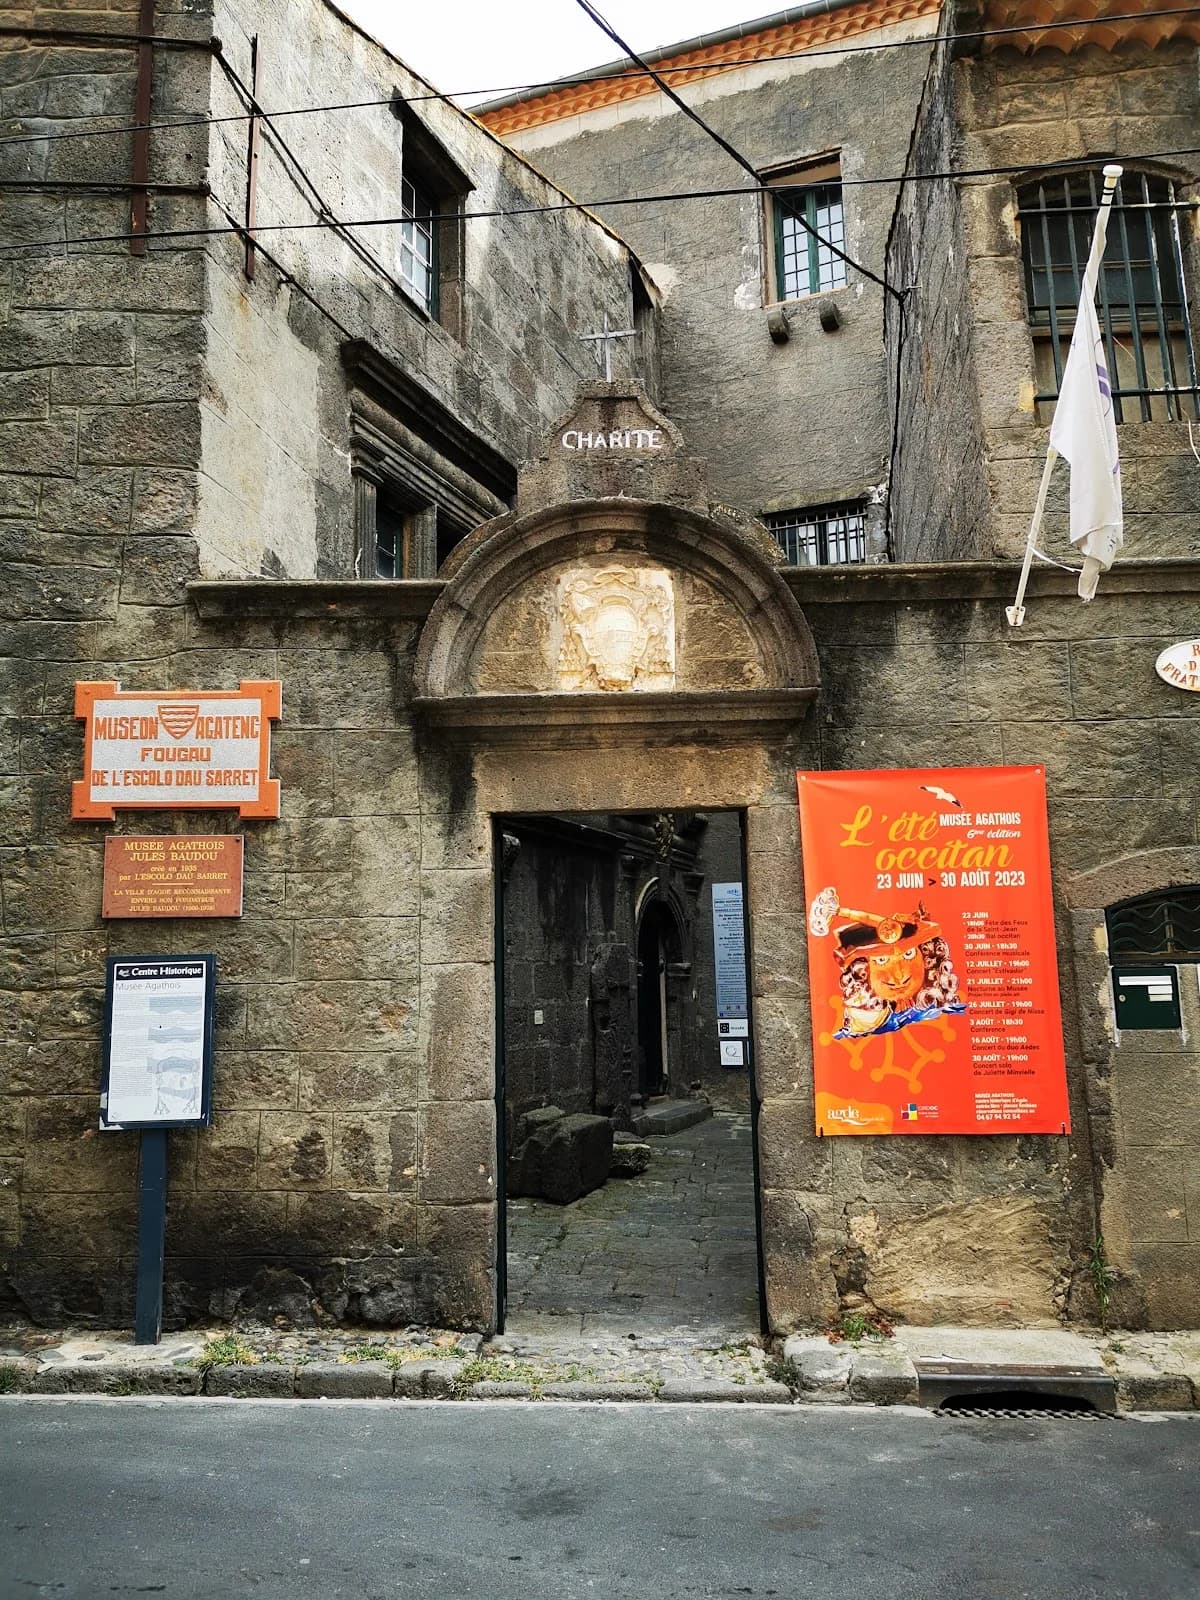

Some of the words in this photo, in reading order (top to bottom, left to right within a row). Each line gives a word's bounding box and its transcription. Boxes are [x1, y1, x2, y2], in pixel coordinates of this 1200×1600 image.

[94, 716, 159, 740] MUSEON
[141, 747, 212, 762] FOUGAU
[92, 770, 109, 786] DE
[112, 769, 173, 786] L'ESCOLO
[175, 770, 202, 786] DAU
[206, 769, 258, 786] SARRET
[939, 812, 972, 827] MUSÉE
[975, 812, 1021, 826] AGATHOIS
[839, 805, 940, 847] L'été
[987, 828, 1021, 839] édition
[169, 841, 225, 850] AGATHOIS
[130, 852, 166, 861] JULES
[171, 852, 218, 861] BAUDOU
[875, 839, 1014, 871] occitan
[120, 873, 131, 882] par
[197, 872, 228, 880] SARRET
[877, 874, 892, 889] 23
[896, 873, 924, 889] JUIN
[941, 872, 956, 887] 30
[960, 868, 990, 886] AOÛT
[995, 871, 1025, 886] 2023
[972, 911, 988, 919] JUIN
[996, 942, 1018, 950] 18h30
[131, 968, 158, 976] Centre
[160, 966, 202, 976] Historique
[1011, 977, 1033, 985] 21h00
[976, 1018, 994, 1026] AOÛT
[1002, 1018, 1024, 1026] 18h30
[982, 1053, 1001, 1061] AOÛT
